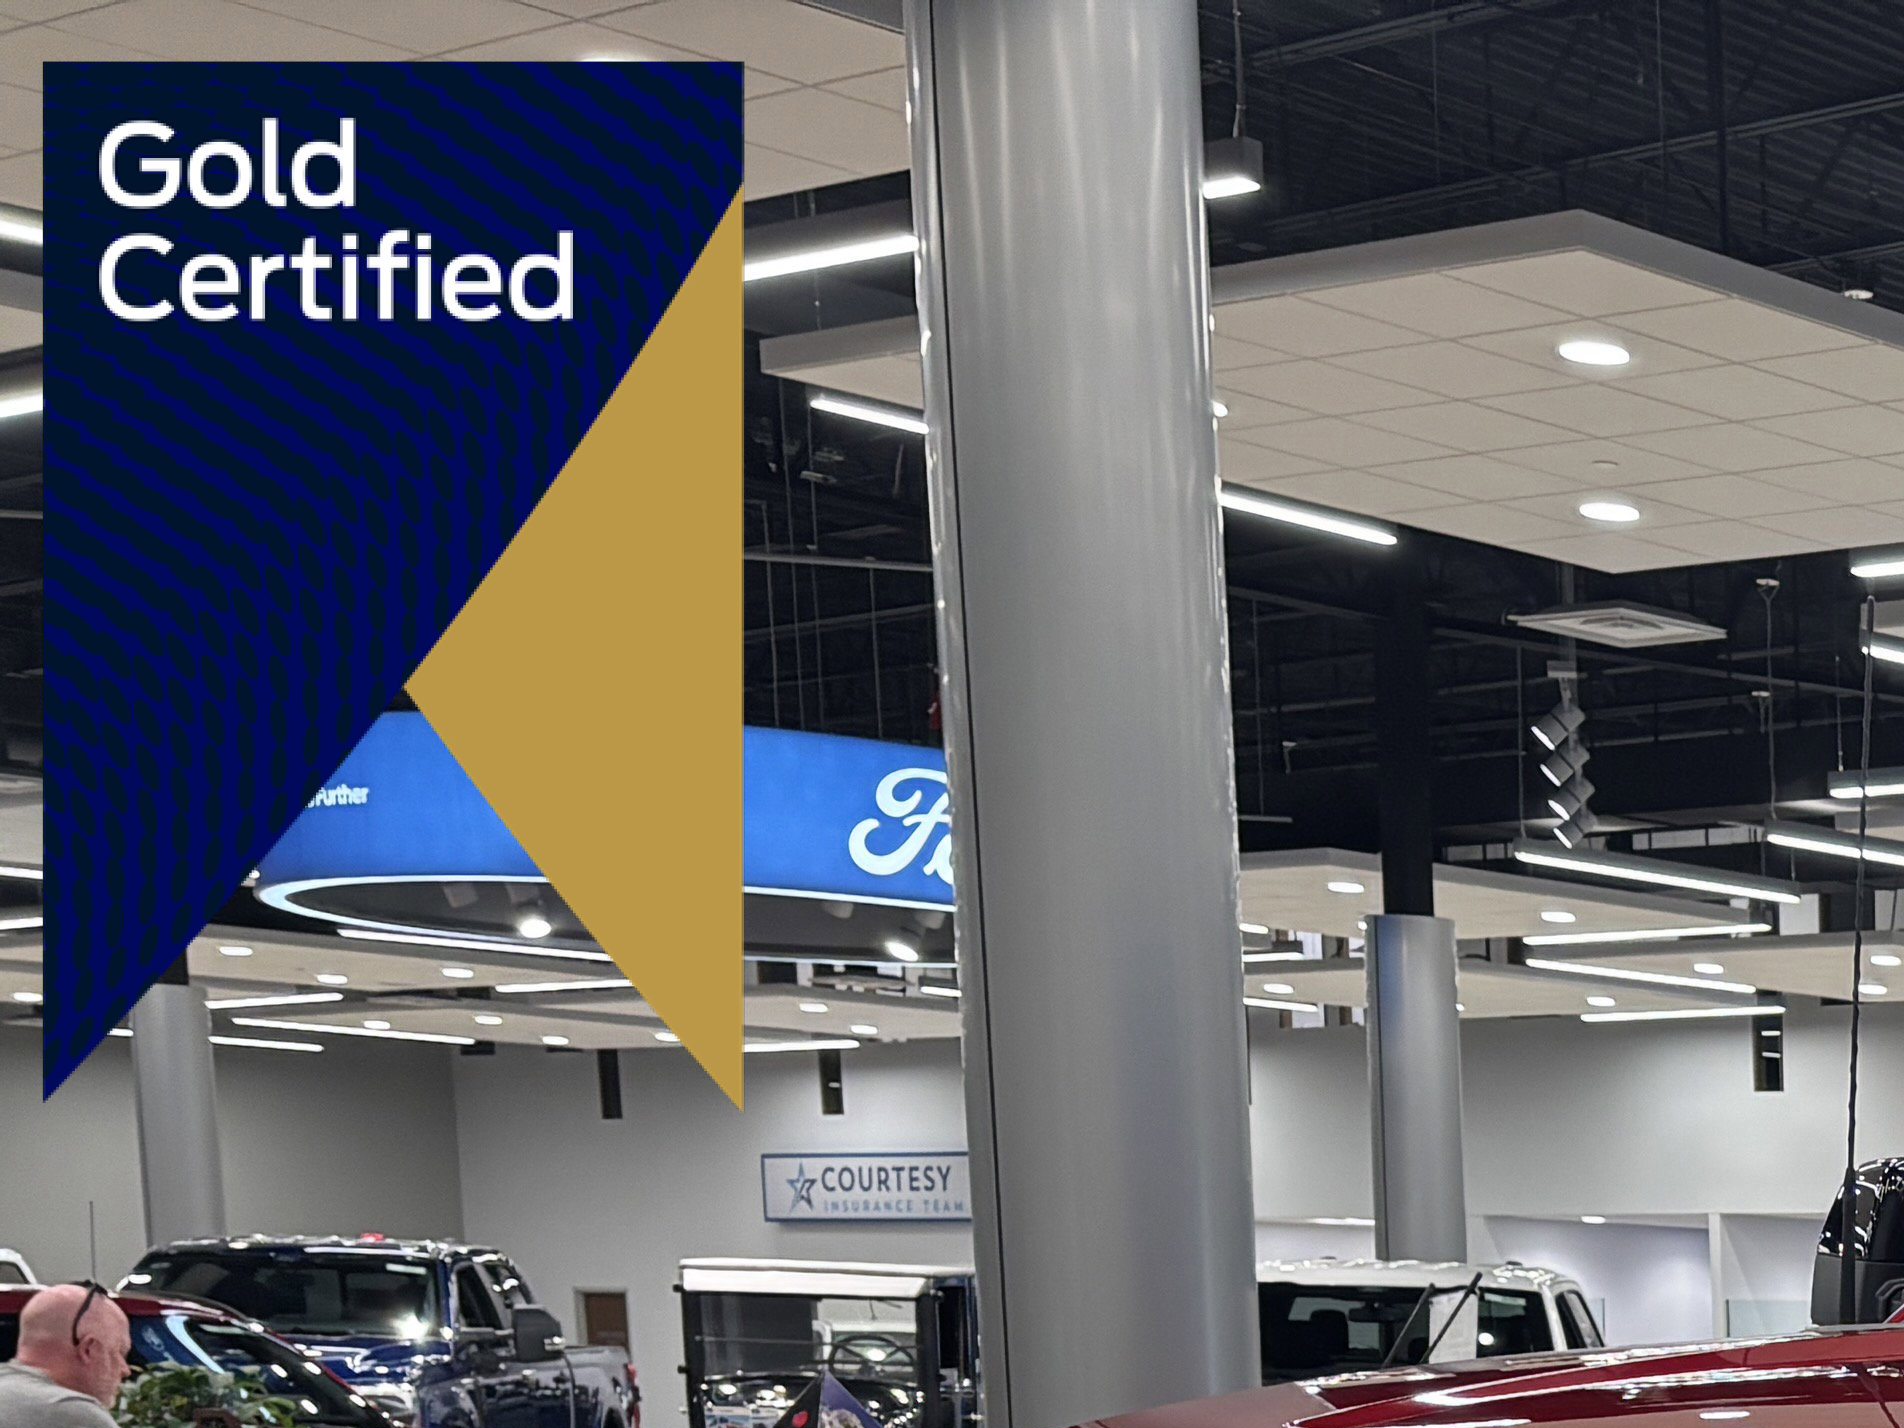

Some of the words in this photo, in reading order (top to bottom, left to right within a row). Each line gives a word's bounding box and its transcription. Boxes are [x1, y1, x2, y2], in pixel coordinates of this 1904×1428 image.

[821, 1164, 952, 1193] COURTESY
[823, 1199, 914, 1214] INSURANCE
[922, 1199, 965, 1214] TEAM
